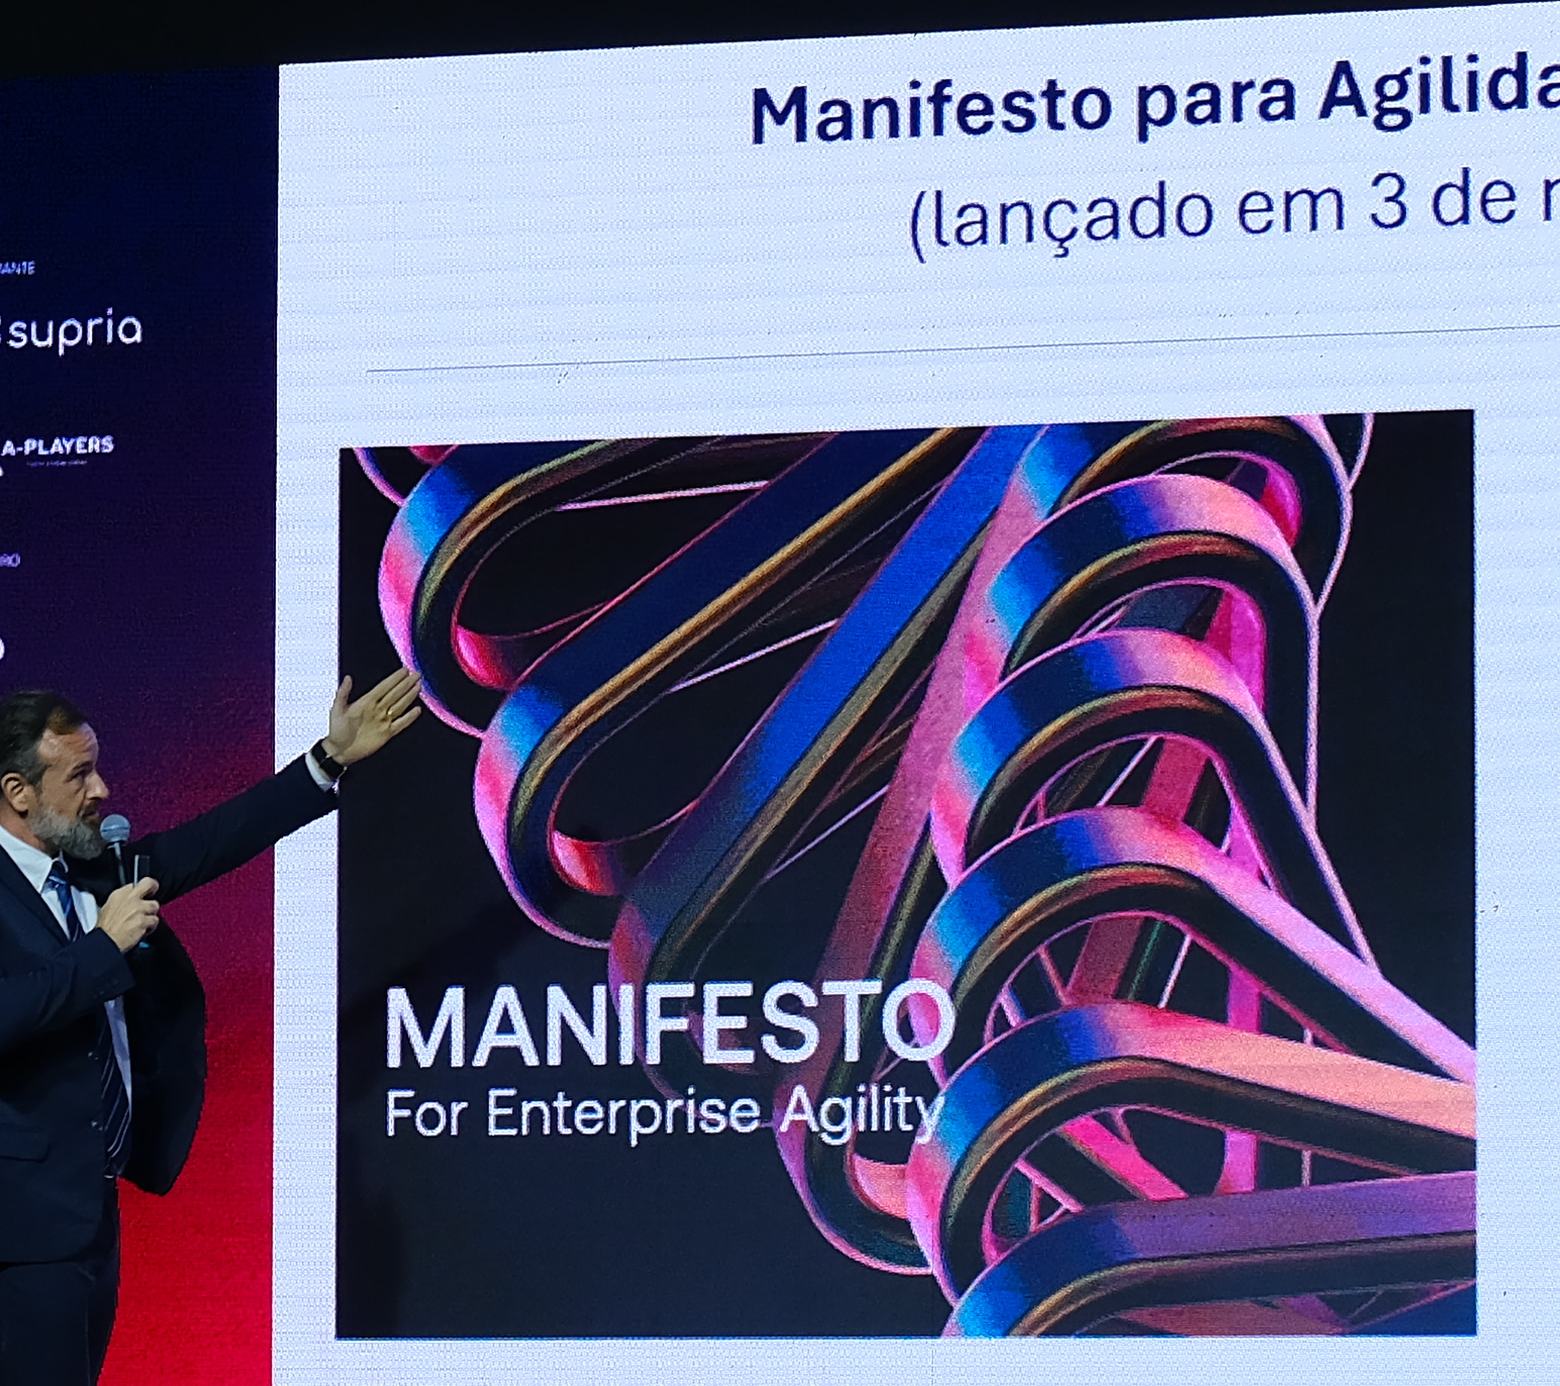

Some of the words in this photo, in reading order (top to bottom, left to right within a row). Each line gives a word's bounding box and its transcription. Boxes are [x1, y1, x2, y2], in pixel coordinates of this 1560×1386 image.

[753, 79, 1111, 144] Manifesto
[1138, 78, 1295, 143] para
[911, 181, 1213, 263] (lançado
[1239, 188, 1344, 234] em
[1371, 172, 1407, 229] 3
[1433, 167, 1516, 226] de
[8, 308, 142, 356] supria
[1, 436, 114, 456] A-PLAYERS
[386, 980, 956, 1067] MANIFESTO
[388, 1090, 468, 1136] For
[487, 1087, 761, 1146] Enterprise
[780, 1084, 944, 1144] Agility
